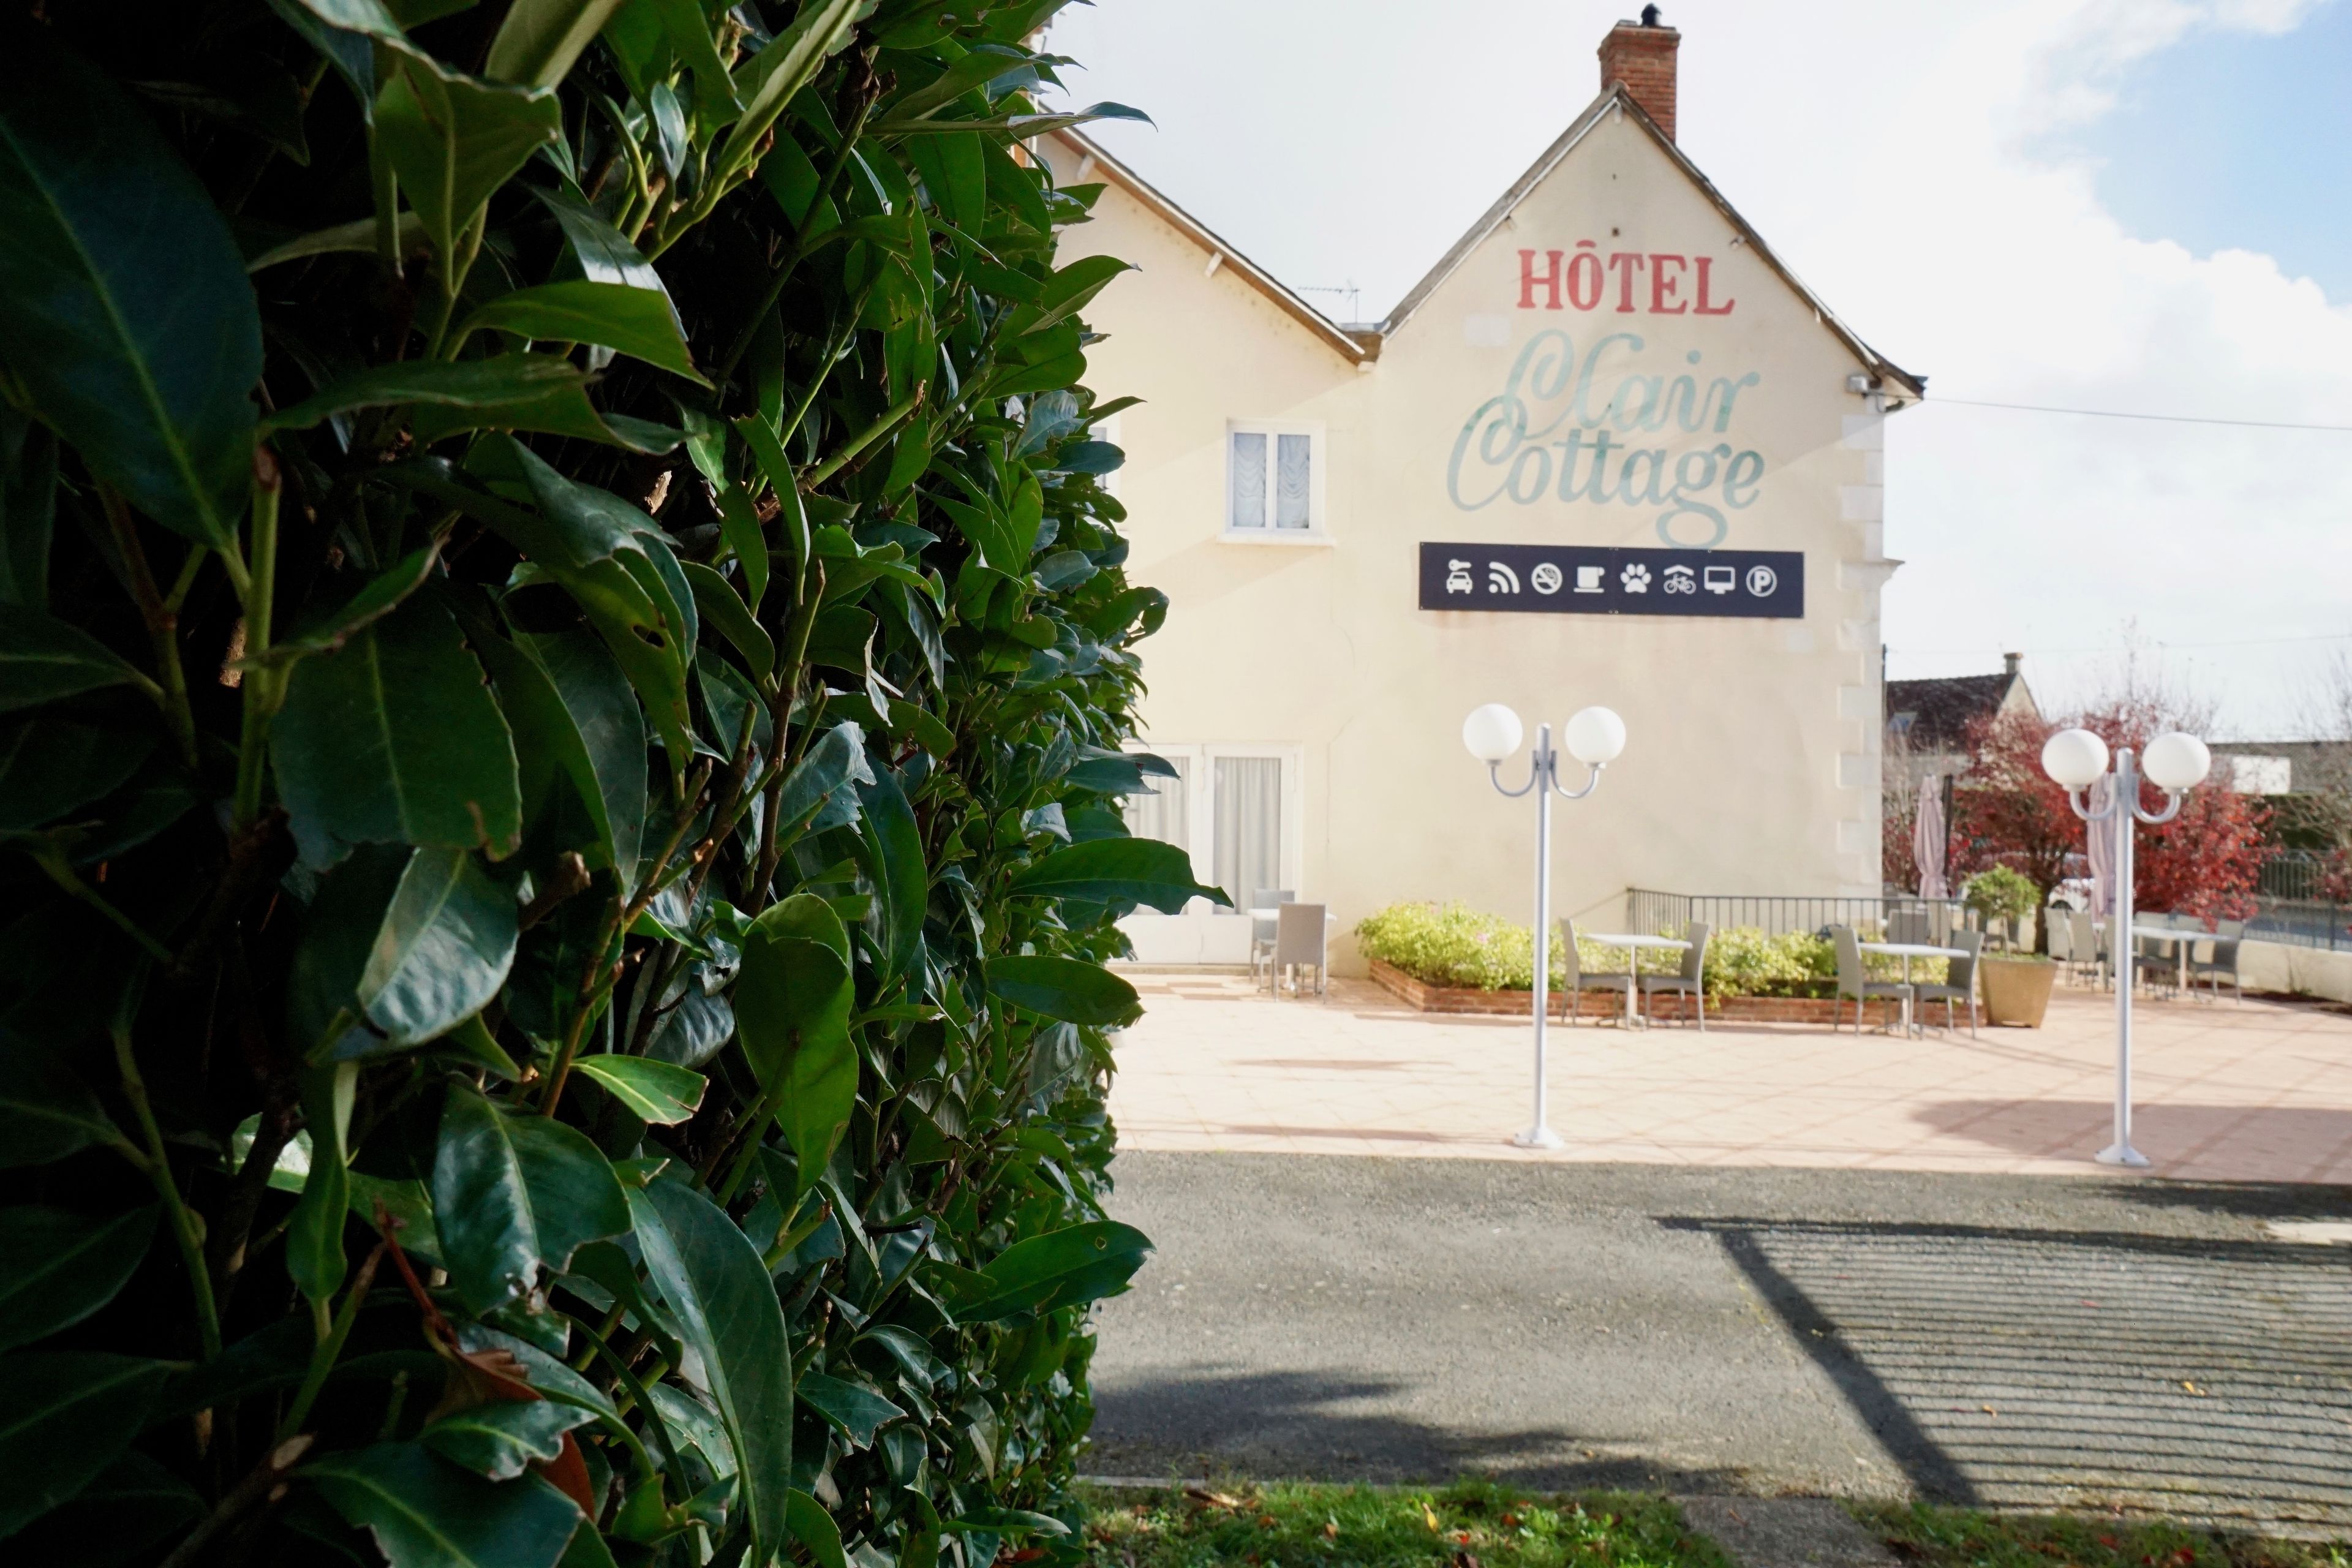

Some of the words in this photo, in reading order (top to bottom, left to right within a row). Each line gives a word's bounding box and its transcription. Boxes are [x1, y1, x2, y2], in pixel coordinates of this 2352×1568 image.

[1516, 239, 1736, 315] HÔTEL
[1504, 329, 1761, 440] Clair
[1447, 394, 1765, 549] Cottage
